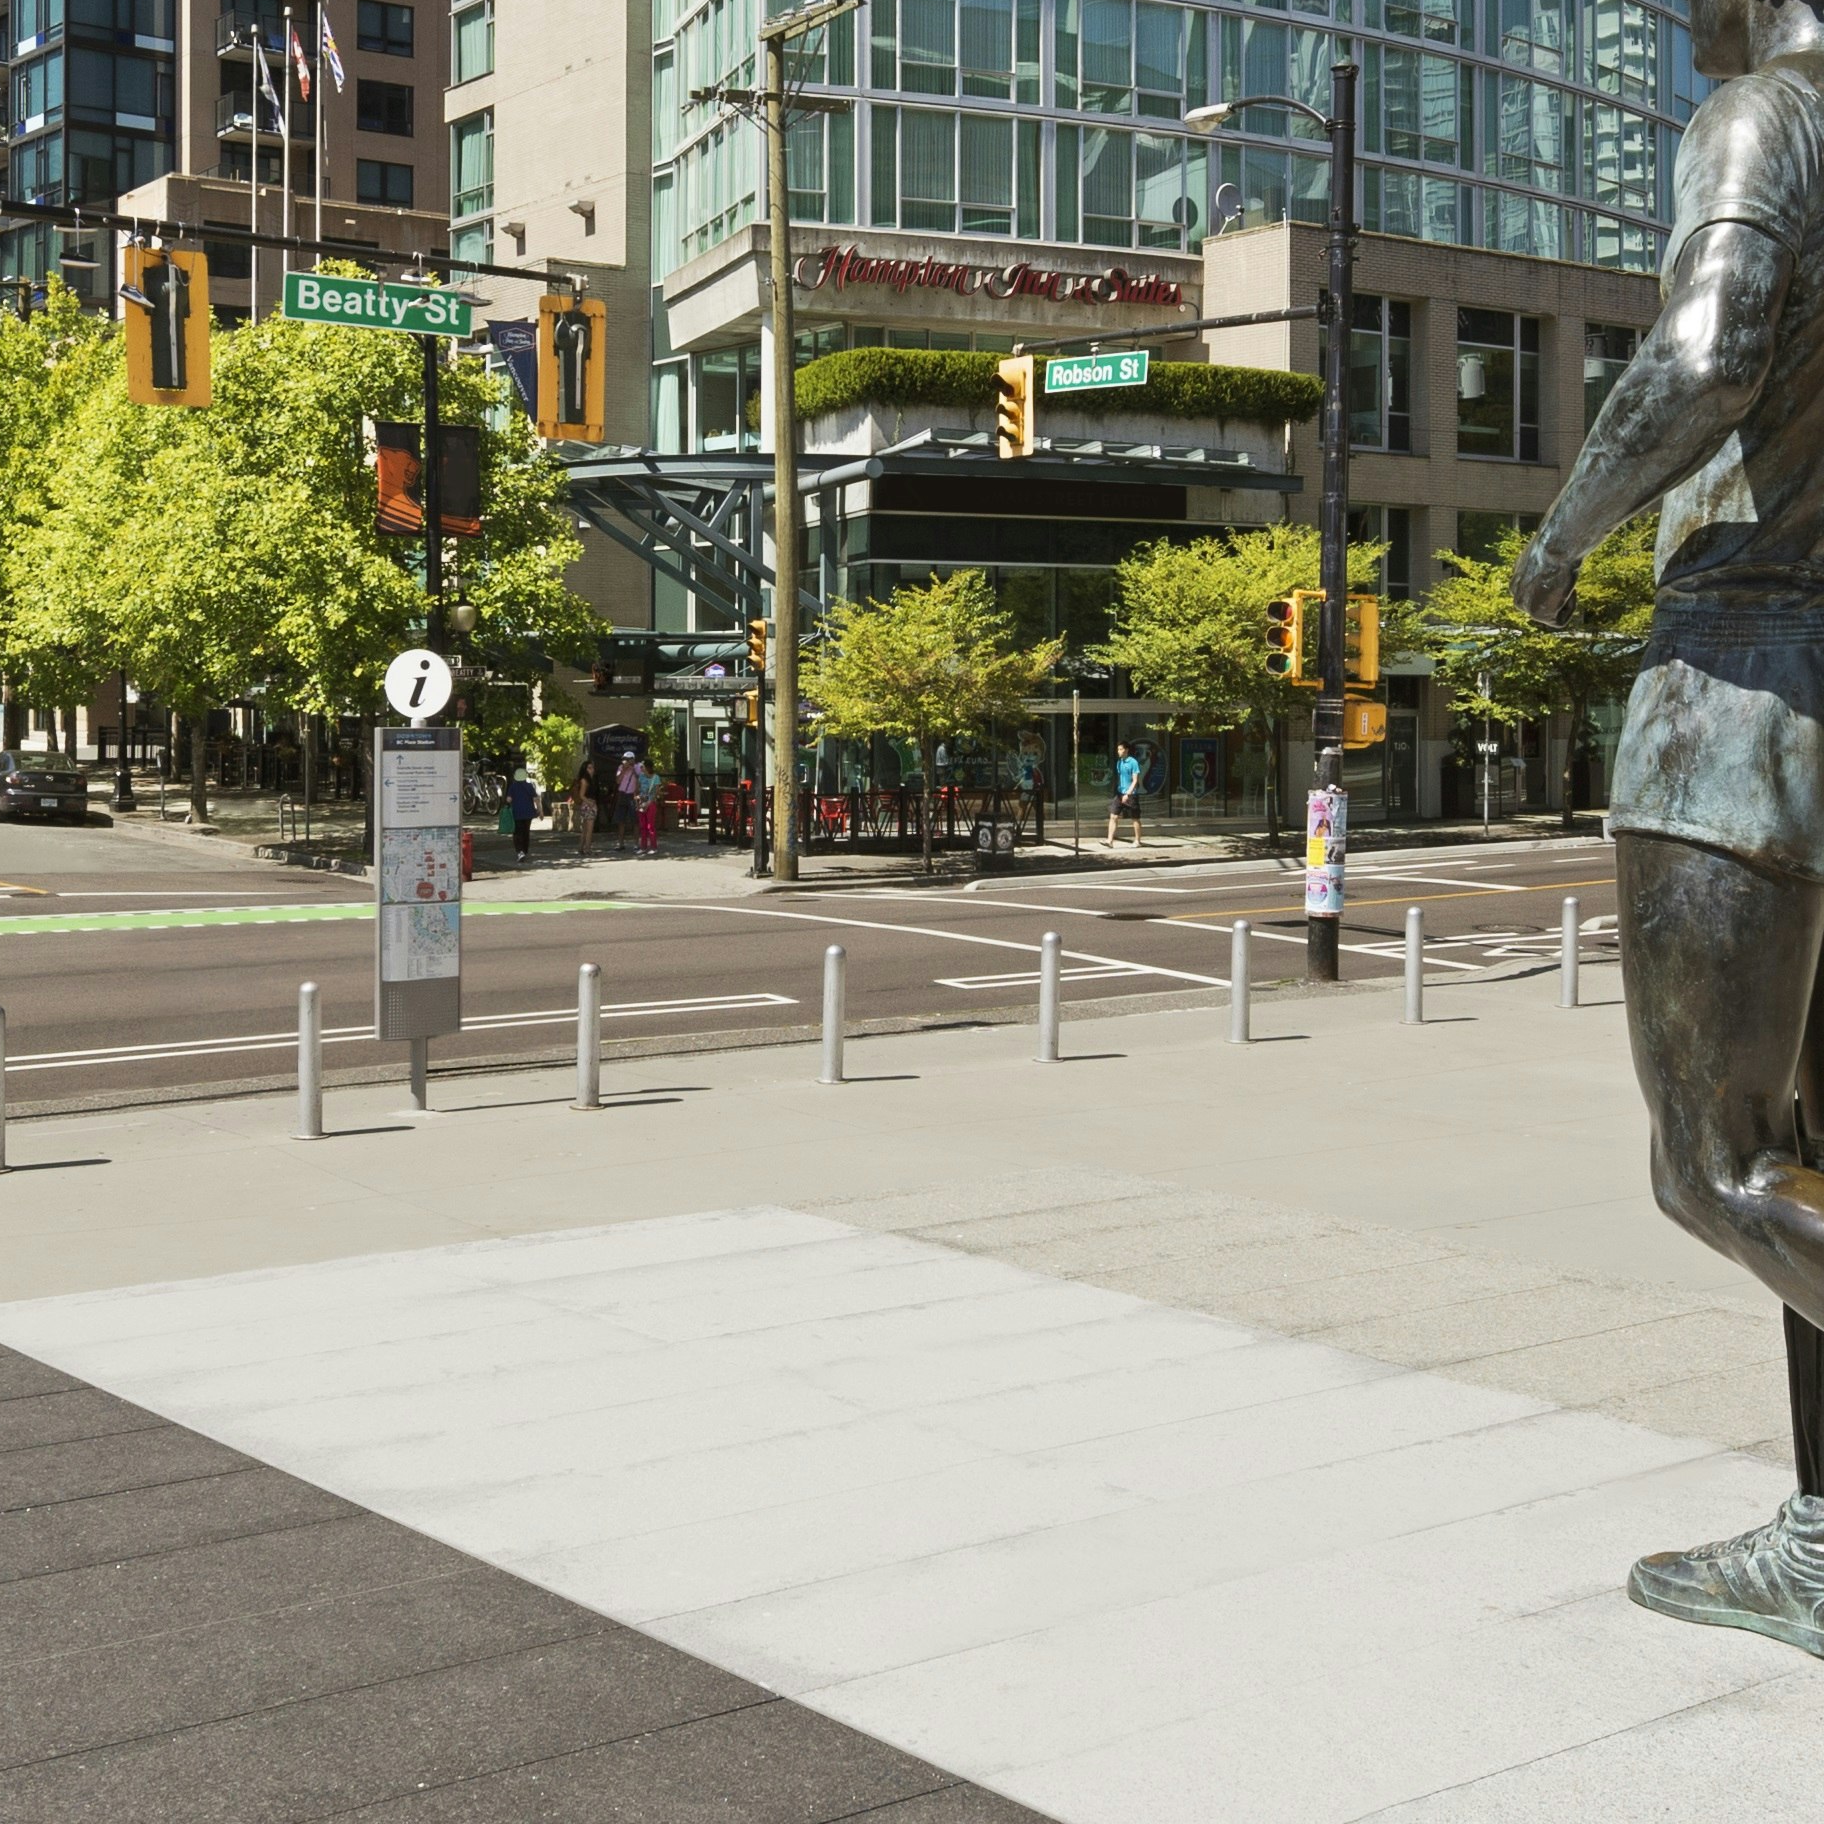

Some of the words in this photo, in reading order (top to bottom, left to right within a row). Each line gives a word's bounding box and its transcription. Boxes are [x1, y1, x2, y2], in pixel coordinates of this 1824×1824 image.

[794, 244, 982, 296] Hampton
[984, 262, 1075, 302] Inn
[1092, 268, 1183, 306] Suites
[297, 279, 410, 325] Beatty
[424, 293, 460, 325] St
[1052, 363, 1113, 386] Robson
[1119, 357, 1140, 380] St
[1477, 743, 1498, 753] VOLT
